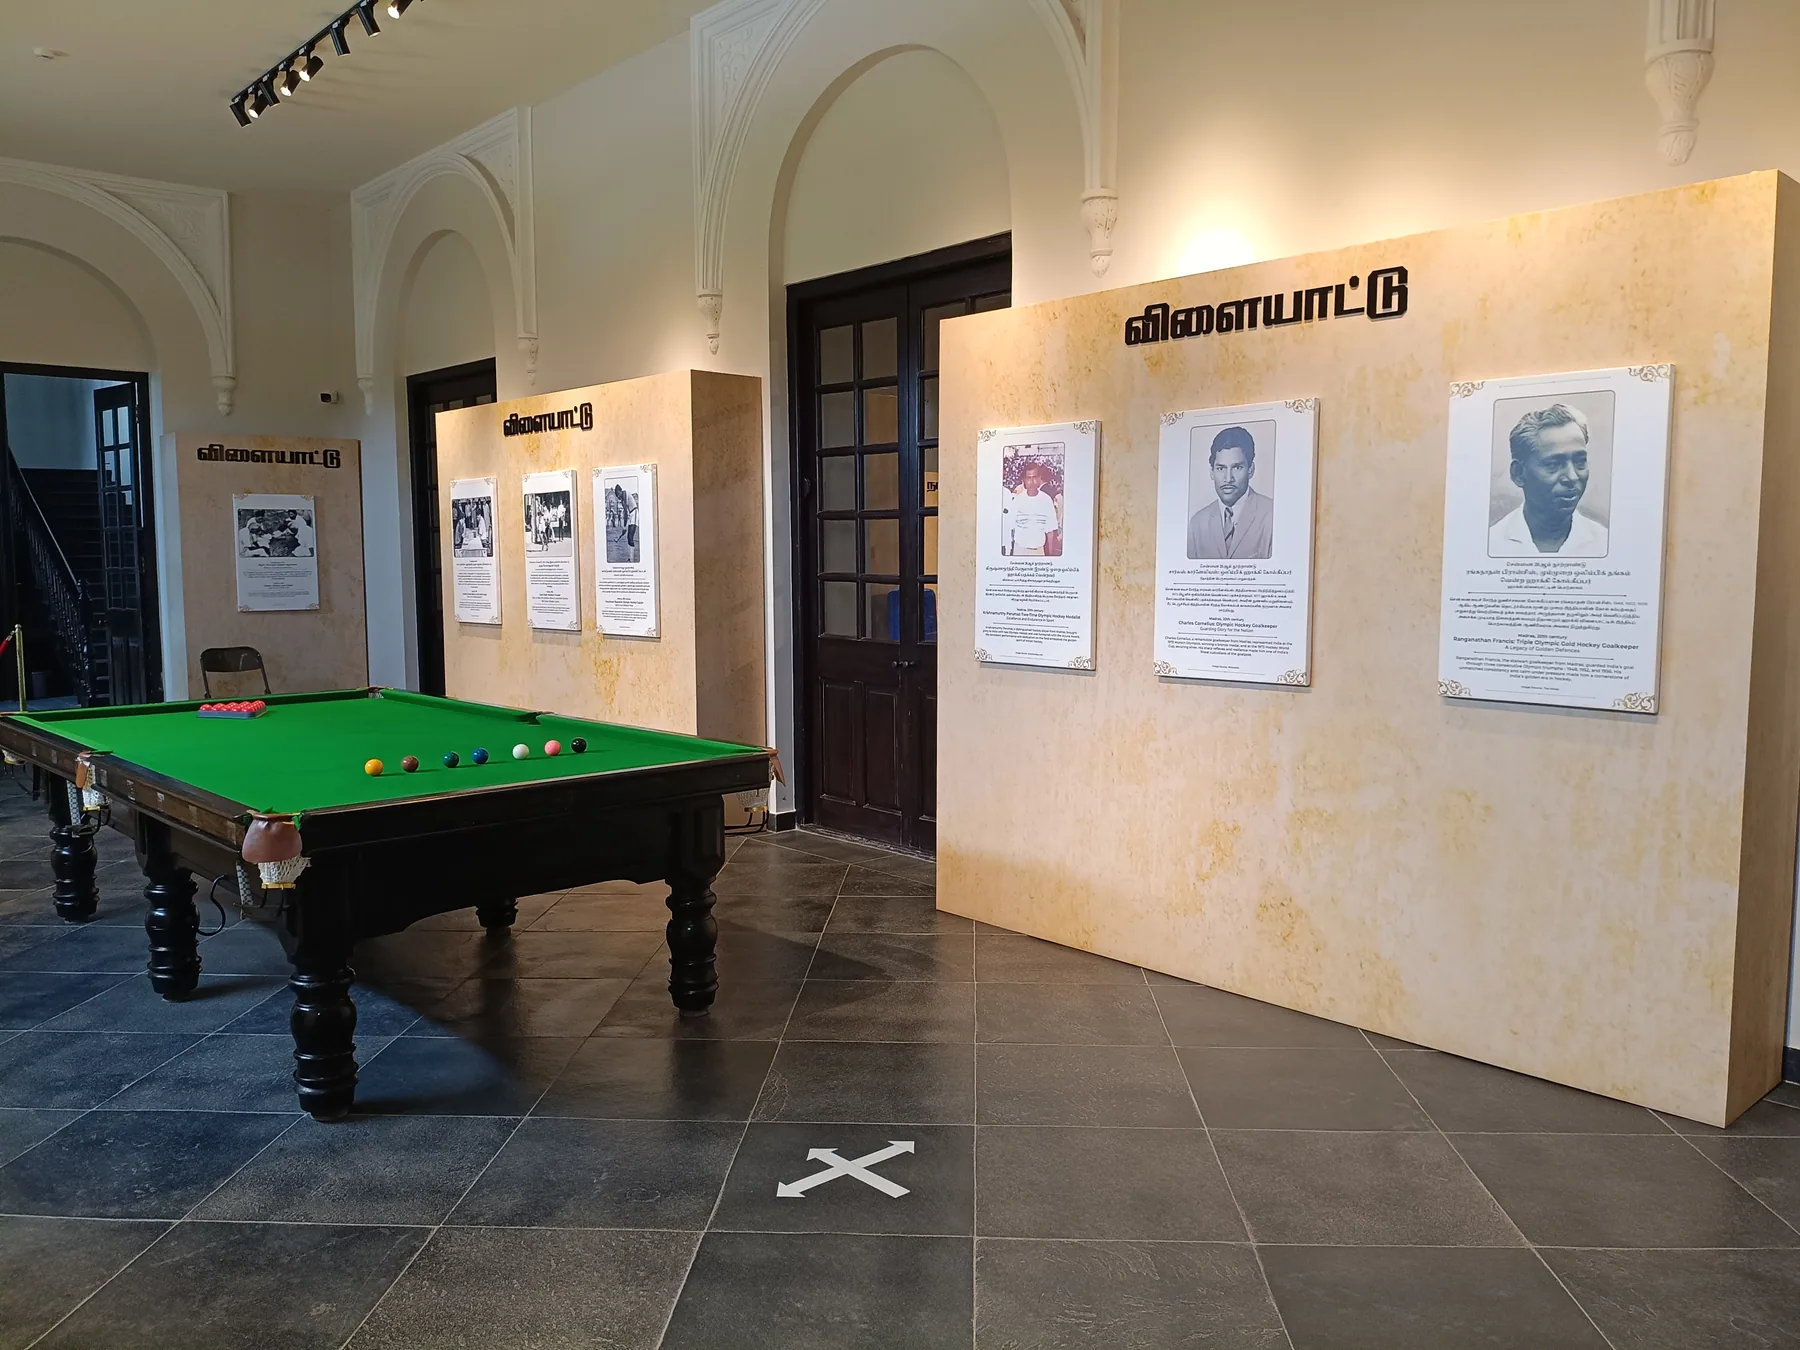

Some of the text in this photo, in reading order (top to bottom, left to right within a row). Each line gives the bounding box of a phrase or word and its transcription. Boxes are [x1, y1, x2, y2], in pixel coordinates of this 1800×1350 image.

[1125, 266, 1408, 345] விளையாட்டு
[503, 402, 594, 437] விளையாட்டு
[197, 444, 341, 468] விளையாட்டு
